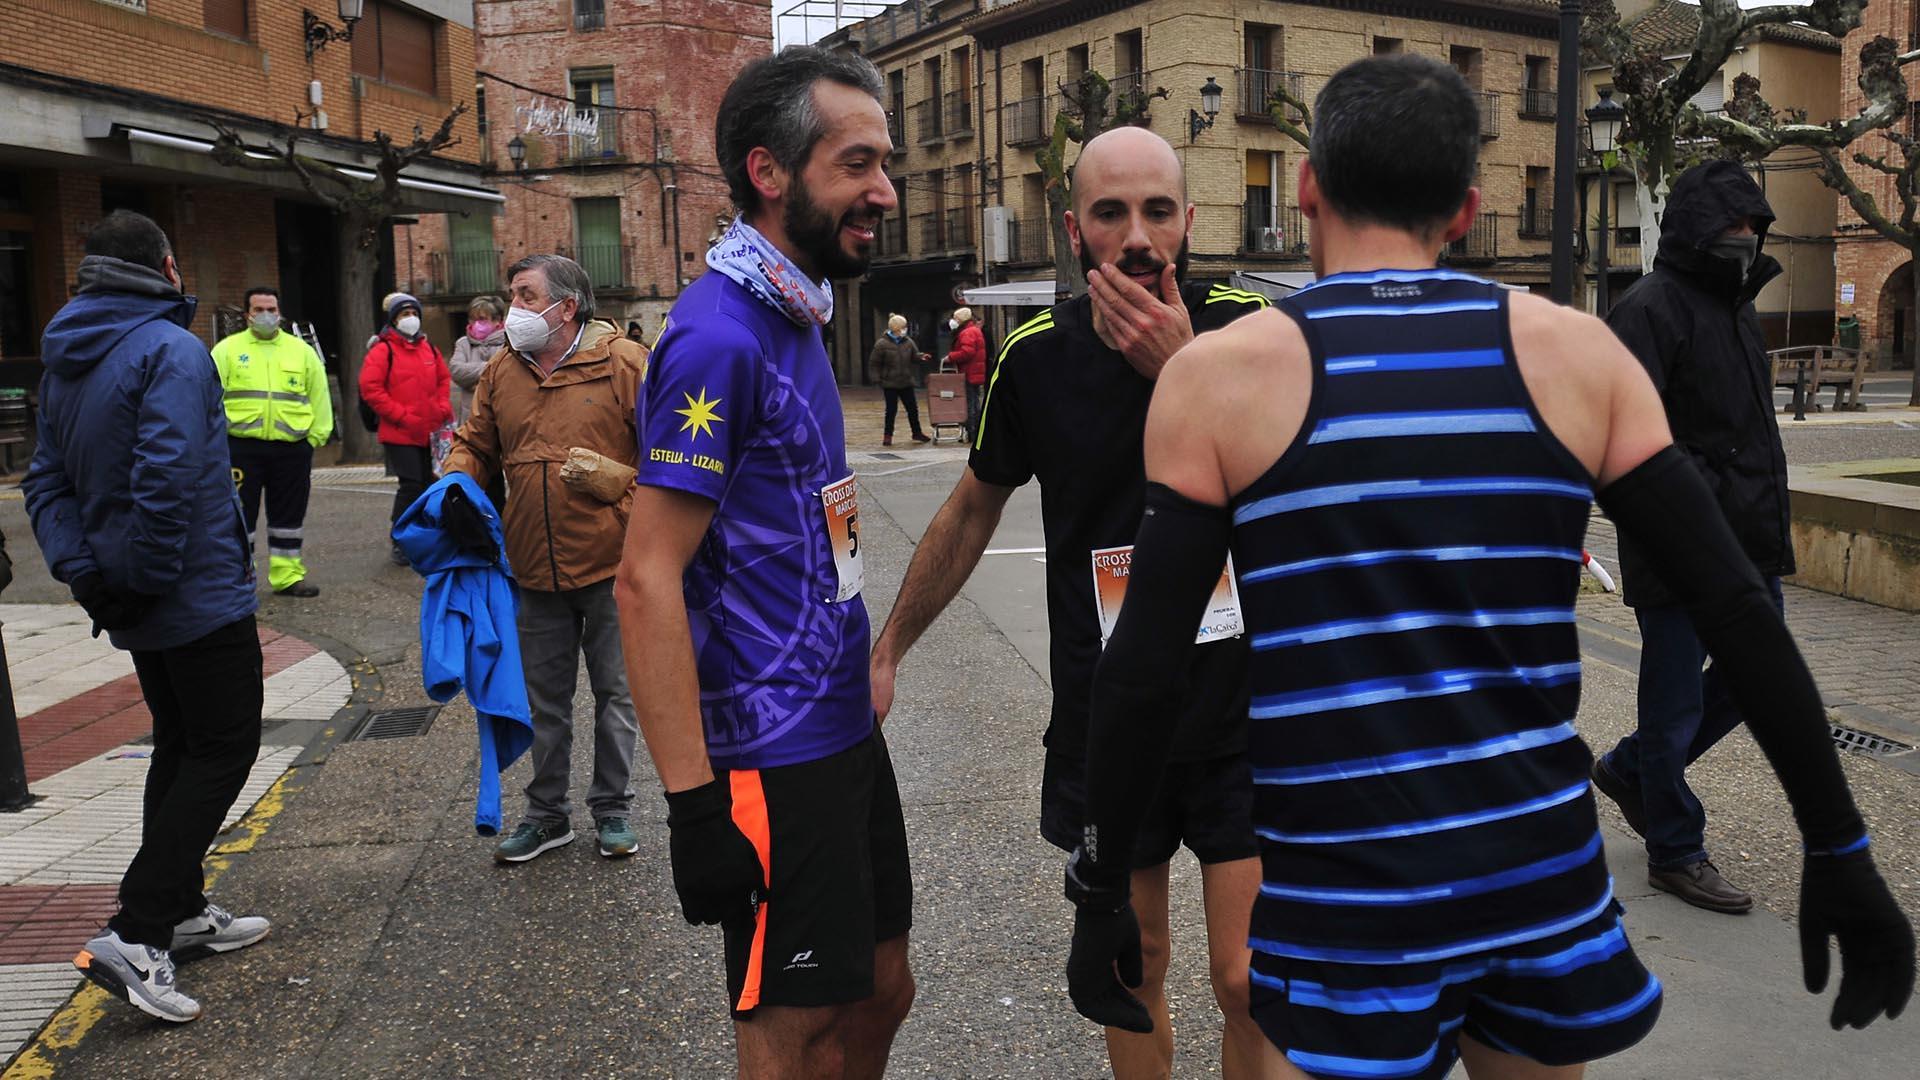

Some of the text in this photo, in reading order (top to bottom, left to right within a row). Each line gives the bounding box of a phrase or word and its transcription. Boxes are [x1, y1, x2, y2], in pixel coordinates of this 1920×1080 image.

[650, 448, 683, 464] ESTELLA
[824, 487, 846, 507] CROSS
[1096, 552, 1132, 568] CROSS
